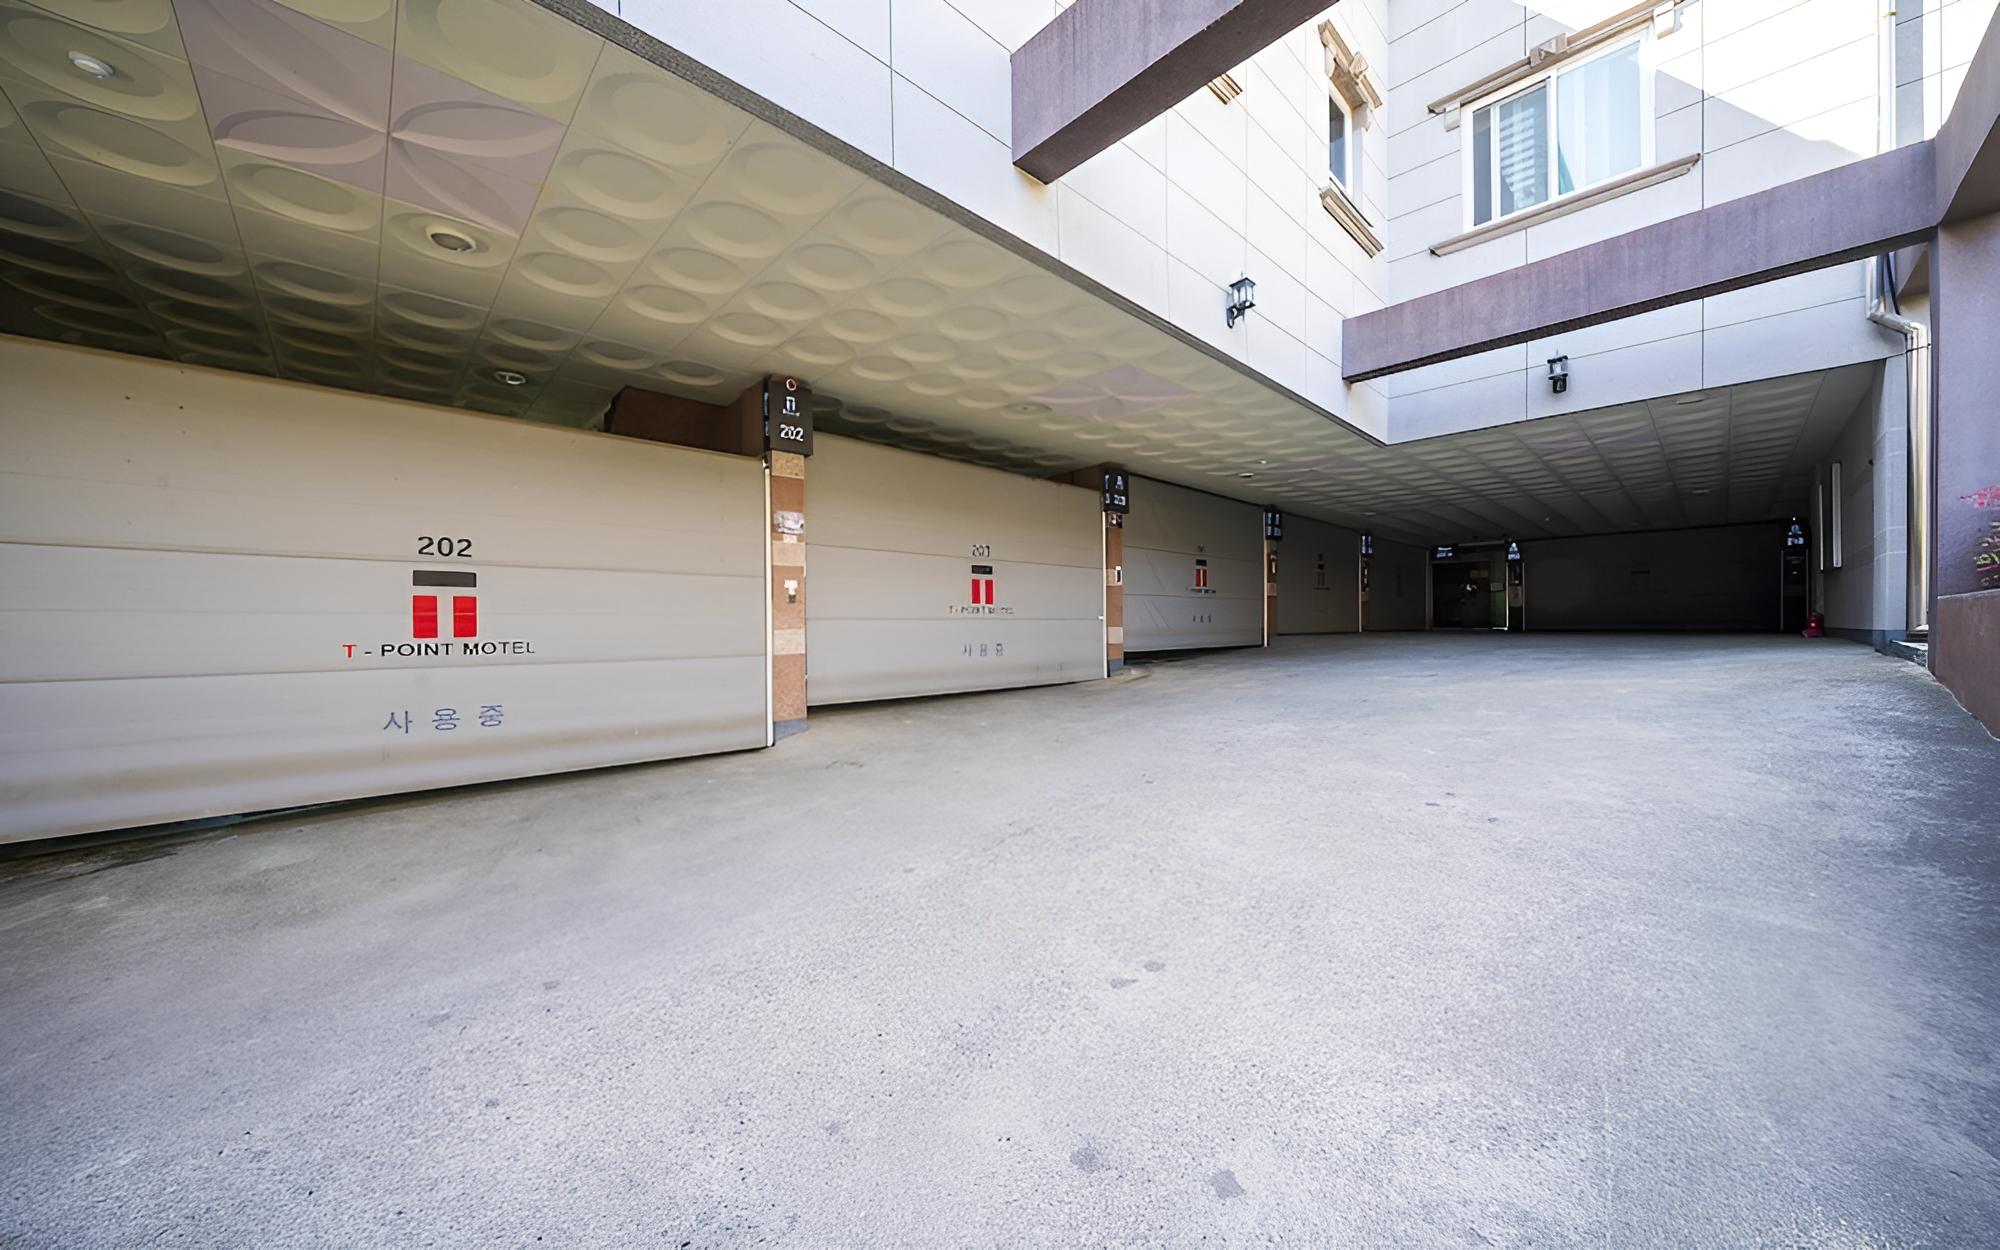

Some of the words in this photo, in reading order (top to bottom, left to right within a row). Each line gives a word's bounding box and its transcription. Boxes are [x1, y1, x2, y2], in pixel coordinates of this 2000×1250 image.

[780, 424, 804, 441] 202
[417, 536, 473, 557] 202
[342, 644, 357, 658] T
[381, 643, 453, 657] POINT
[463, 641, 535, 656] MOTEL
